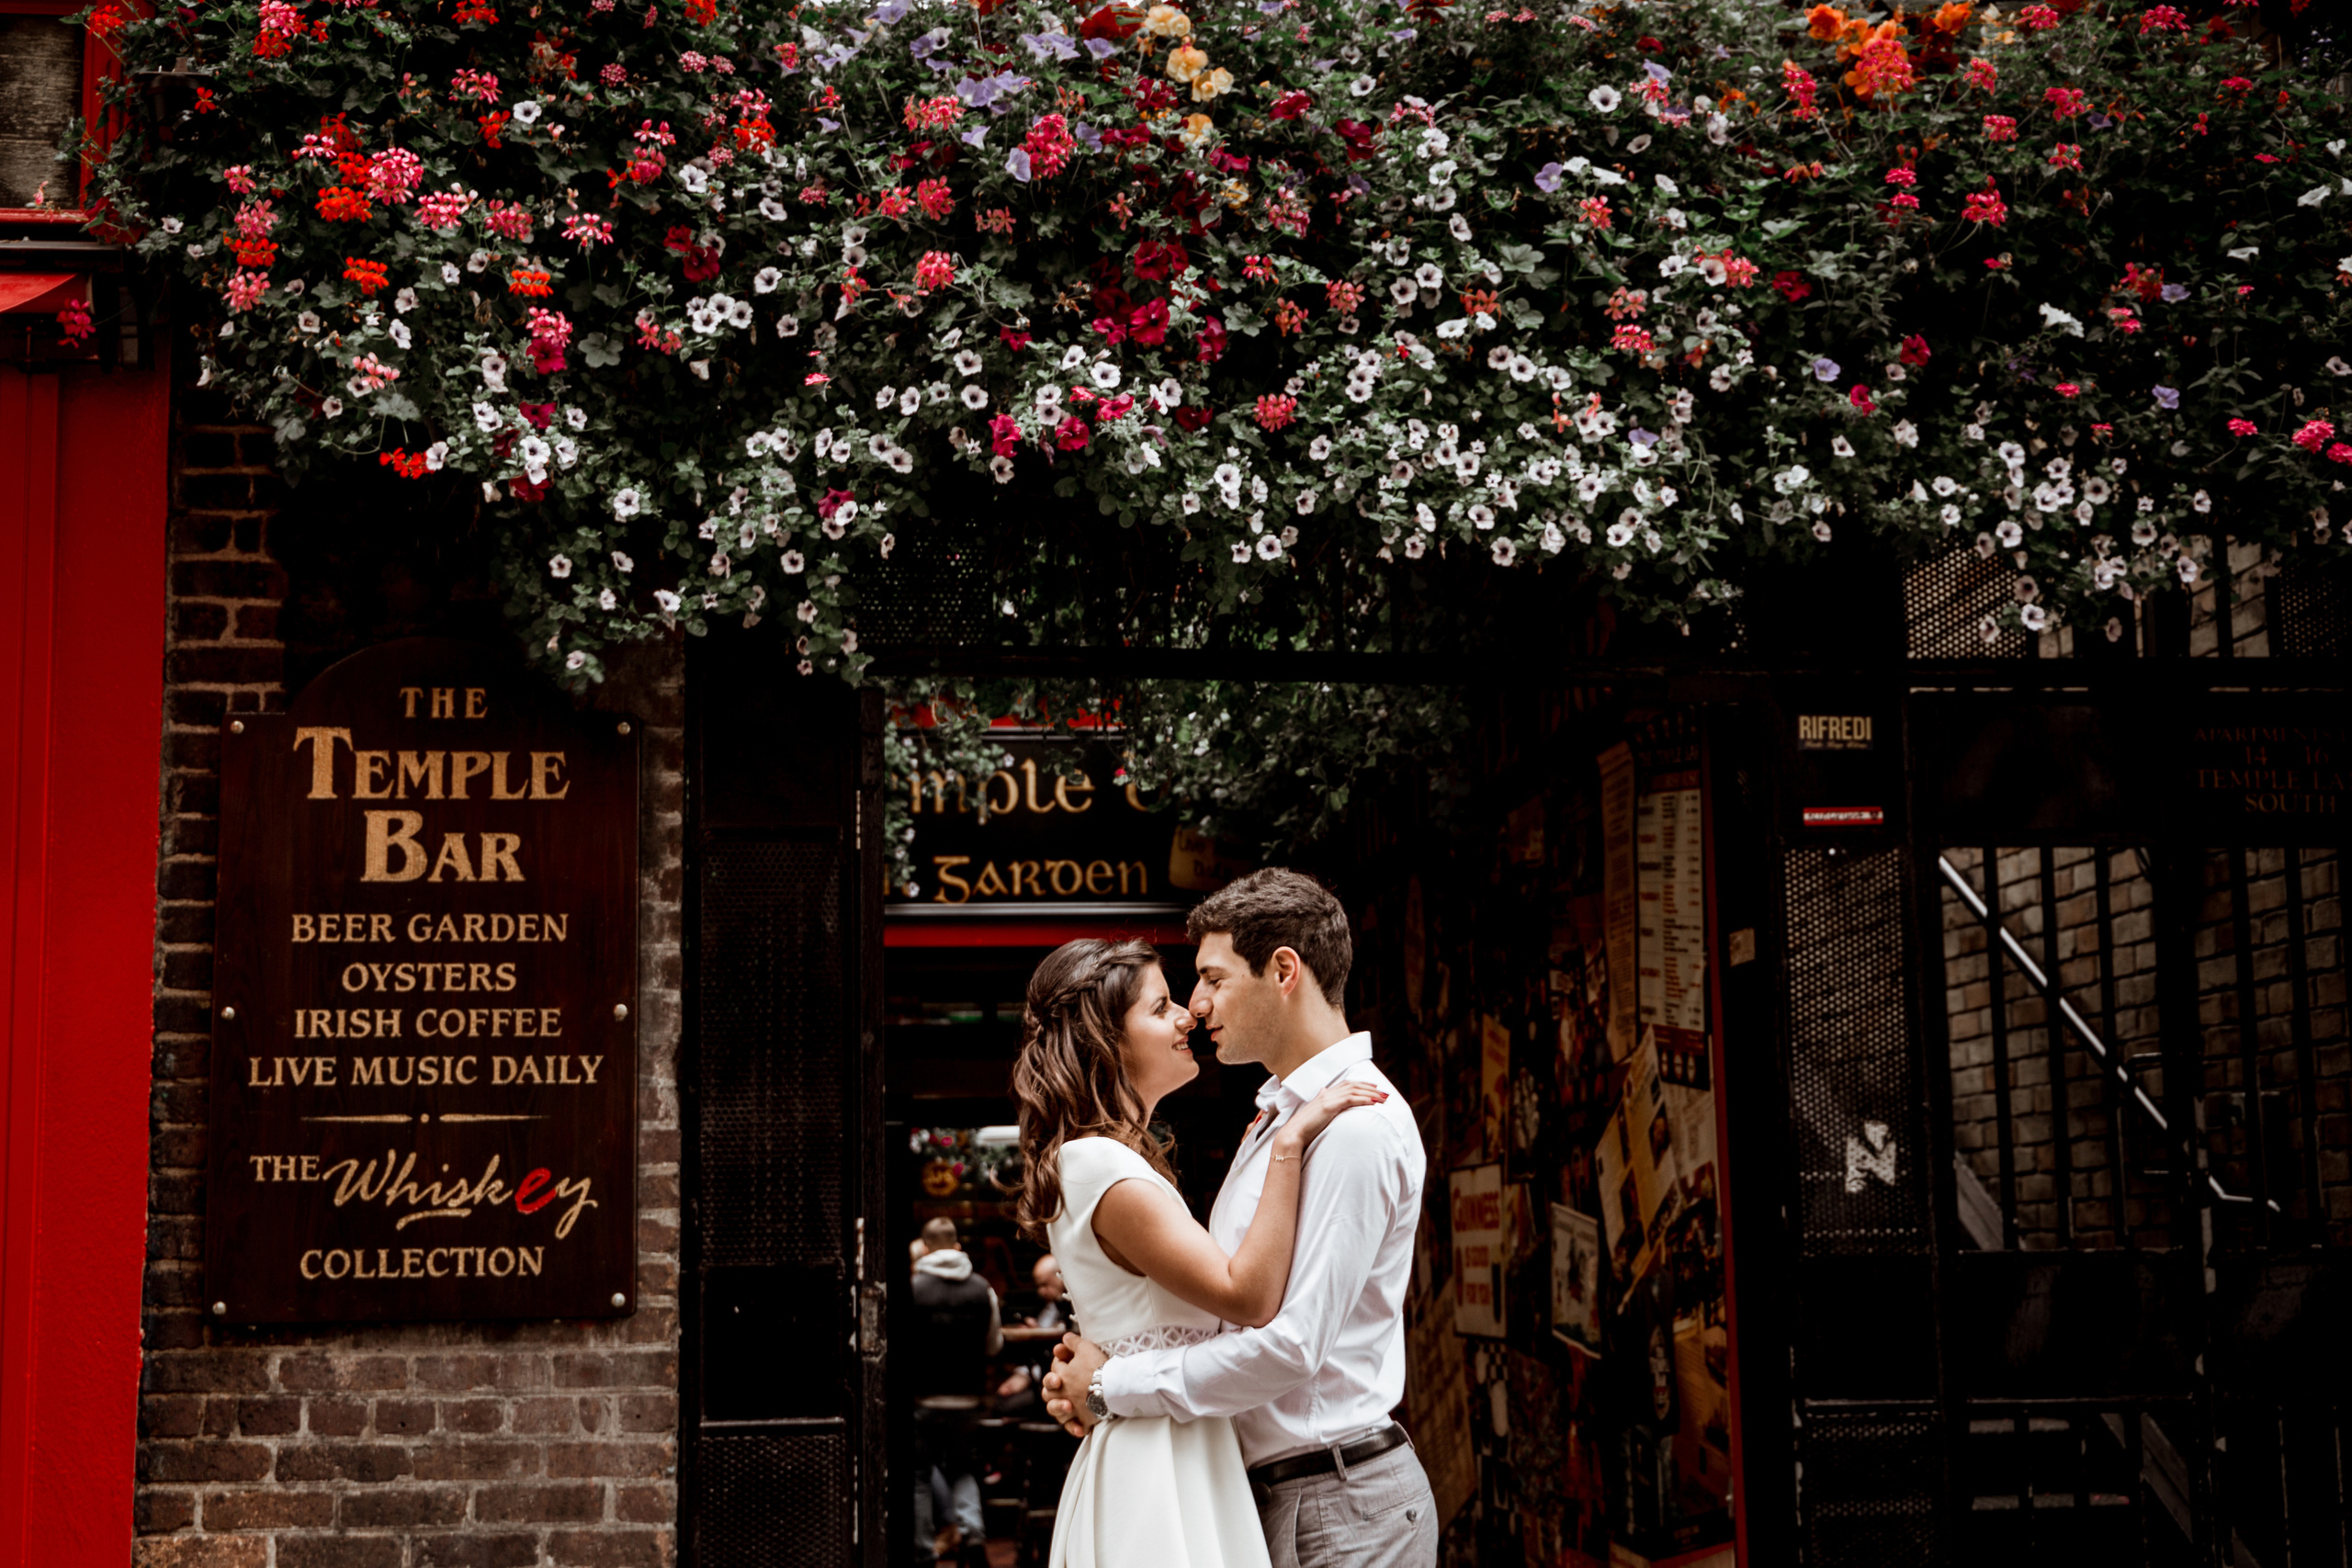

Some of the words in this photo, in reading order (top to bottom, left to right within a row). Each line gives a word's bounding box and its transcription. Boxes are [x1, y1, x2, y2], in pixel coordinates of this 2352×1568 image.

[401, 687, 488, 718] THE
[1799, 715, 1871, 740] RIFREDI
[293, 727, 570, 799] TEMPLE
[2197, 768, 2301, 790] TEMPLE
[2312, 770, 2352, 790] LA
[2245, 793, 2335, 814] SOUTH
[360, 809, 526, 883] BAR
[291, 914, 396, 943] BEER
[408, 913, 569, 943] GARDEN
[342, 962, 517, 993] OYSTERS
[294, 1009, 402, 1039] IRISH
[415, 1008, 562, 1039] COFFEE
[248, 1057, 337, 1086] LIVE
[350, 1055, 478, 1086] MUSIC
[491, 1055, 605, 1085] DAILY
[250, 1155, 321, 1181] THE
[322, 1148, 599, 1240] Whiskey
[300, 1246, 545, 1280] COLLECTION
